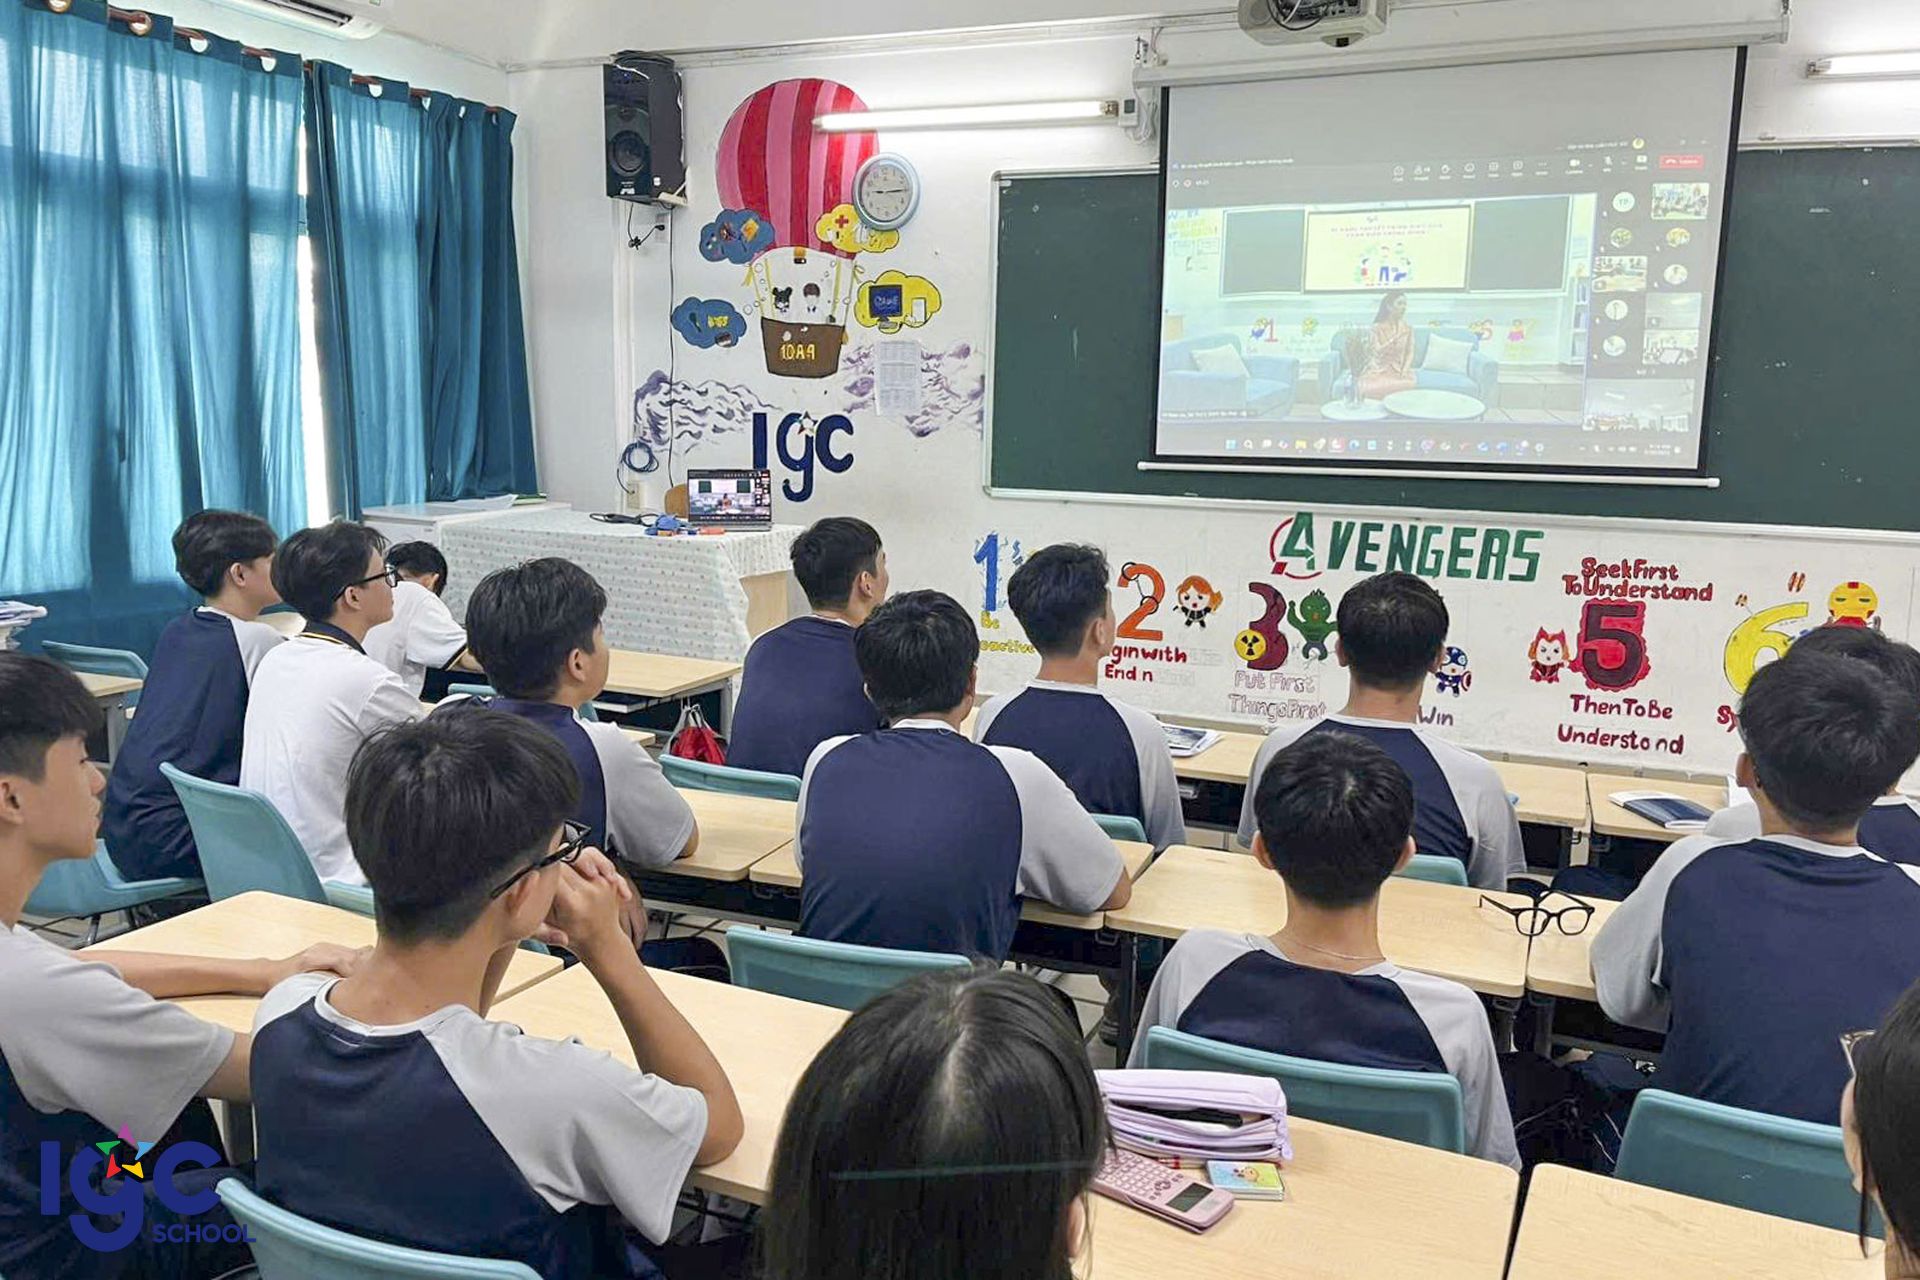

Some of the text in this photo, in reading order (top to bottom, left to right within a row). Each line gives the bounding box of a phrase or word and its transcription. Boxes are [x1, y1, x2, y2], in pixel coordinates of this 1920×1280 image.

[973, 533, 999, 612] 1
[1279, 511, 1544, 582] AVENGERS
[1116, 563, 1166, 642] 2
[1245, 581, 1289, 671] 3
[979, 639, 1036, 655] oactive
[1104, 663, 1137, 682] End
[1234, 669, 1266, 690] Put
[1582, 602, 1644, 689] 5
[1723, 601, 1810, 697] 6
[1716, 705, 1738, 733] Sy
